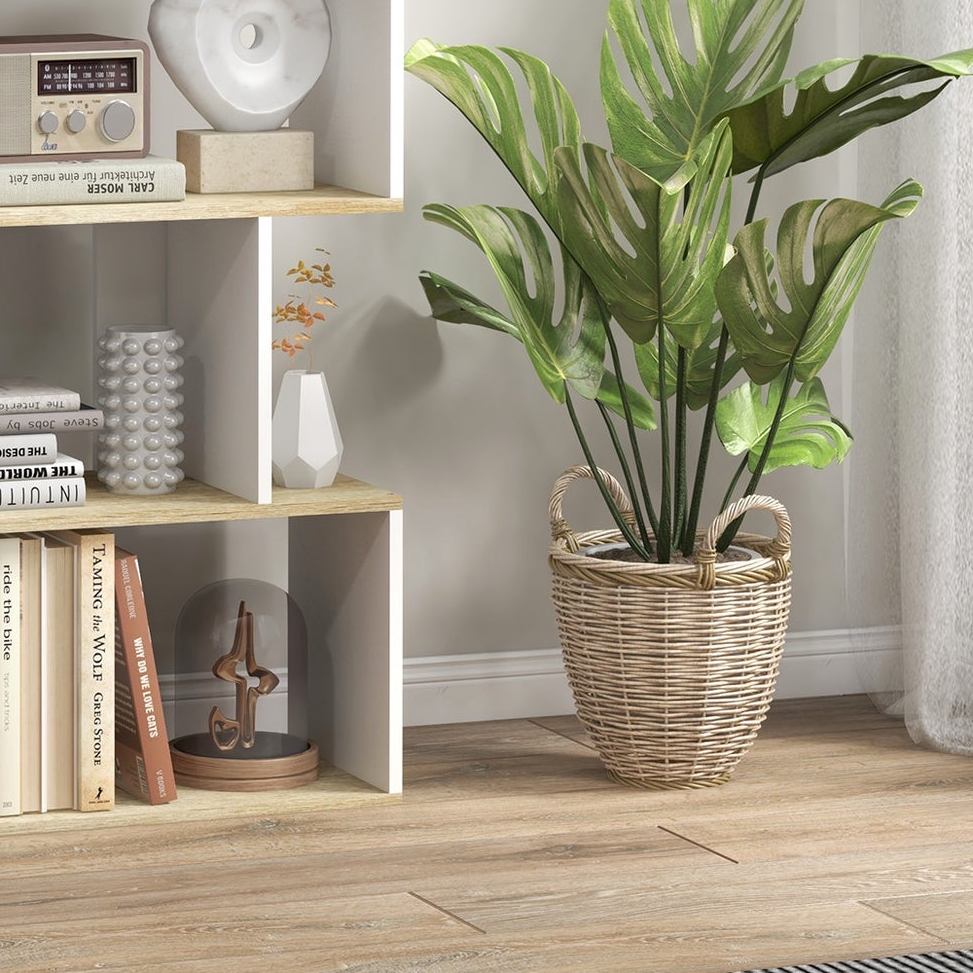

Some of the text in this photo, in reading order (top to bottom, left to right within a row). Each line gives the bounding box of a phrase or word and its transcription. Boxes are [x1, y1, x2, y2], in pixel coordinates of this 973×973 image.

[9, 171, 155, 185] Architektur für eine neue Zeit
[87, 182, 155, 193] CARL MOSER
[46, 400, 65, 409] The
[7, 419, 21, 431] by
[28, 418, 56, 429] Jobs
[63, 416, 99, 427] Steve
[28, 446, 47, 456] THE
[51, 465, 77, 476] THE
[3, 564, 13, 594] ride
[3, 599, 13, 624] the
[3, 629, 13, 661] bike
[92, 544, 106, 766] TAMING the WOLF GREG STONE
[3, 672, 11, 689] tips
[133, 637, 158, 739] WHY DO WE LOVE CATS
